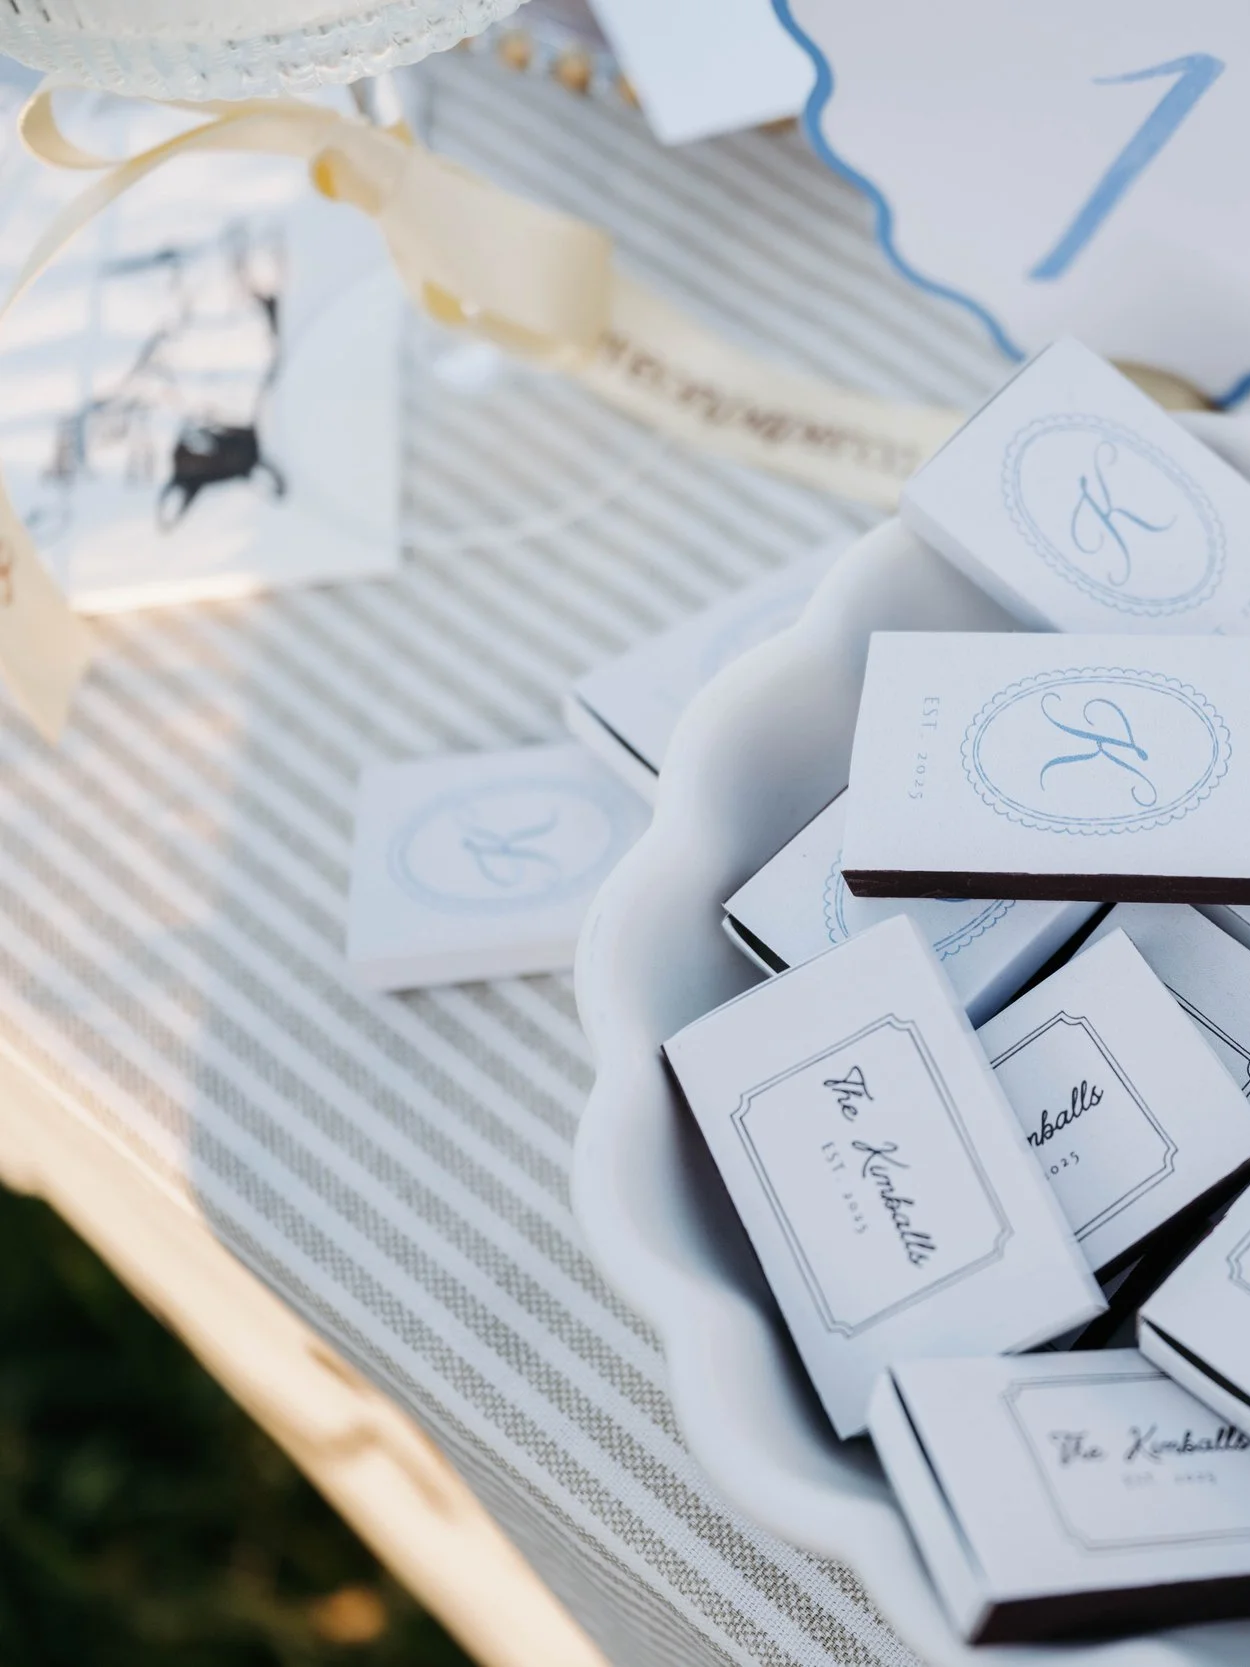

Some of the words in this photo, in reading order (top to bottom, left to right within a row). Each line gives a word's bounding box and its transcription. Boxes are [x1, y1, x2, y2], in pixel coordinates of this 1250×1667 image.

[1070, 440, 1178, 588] K
[1039, 691, 1158, 807] K
[823, 1065, 874, 1122] The
[851, 1140, 937, 1268] Kimballs
[1050, 1429, 1104, 1467] The
